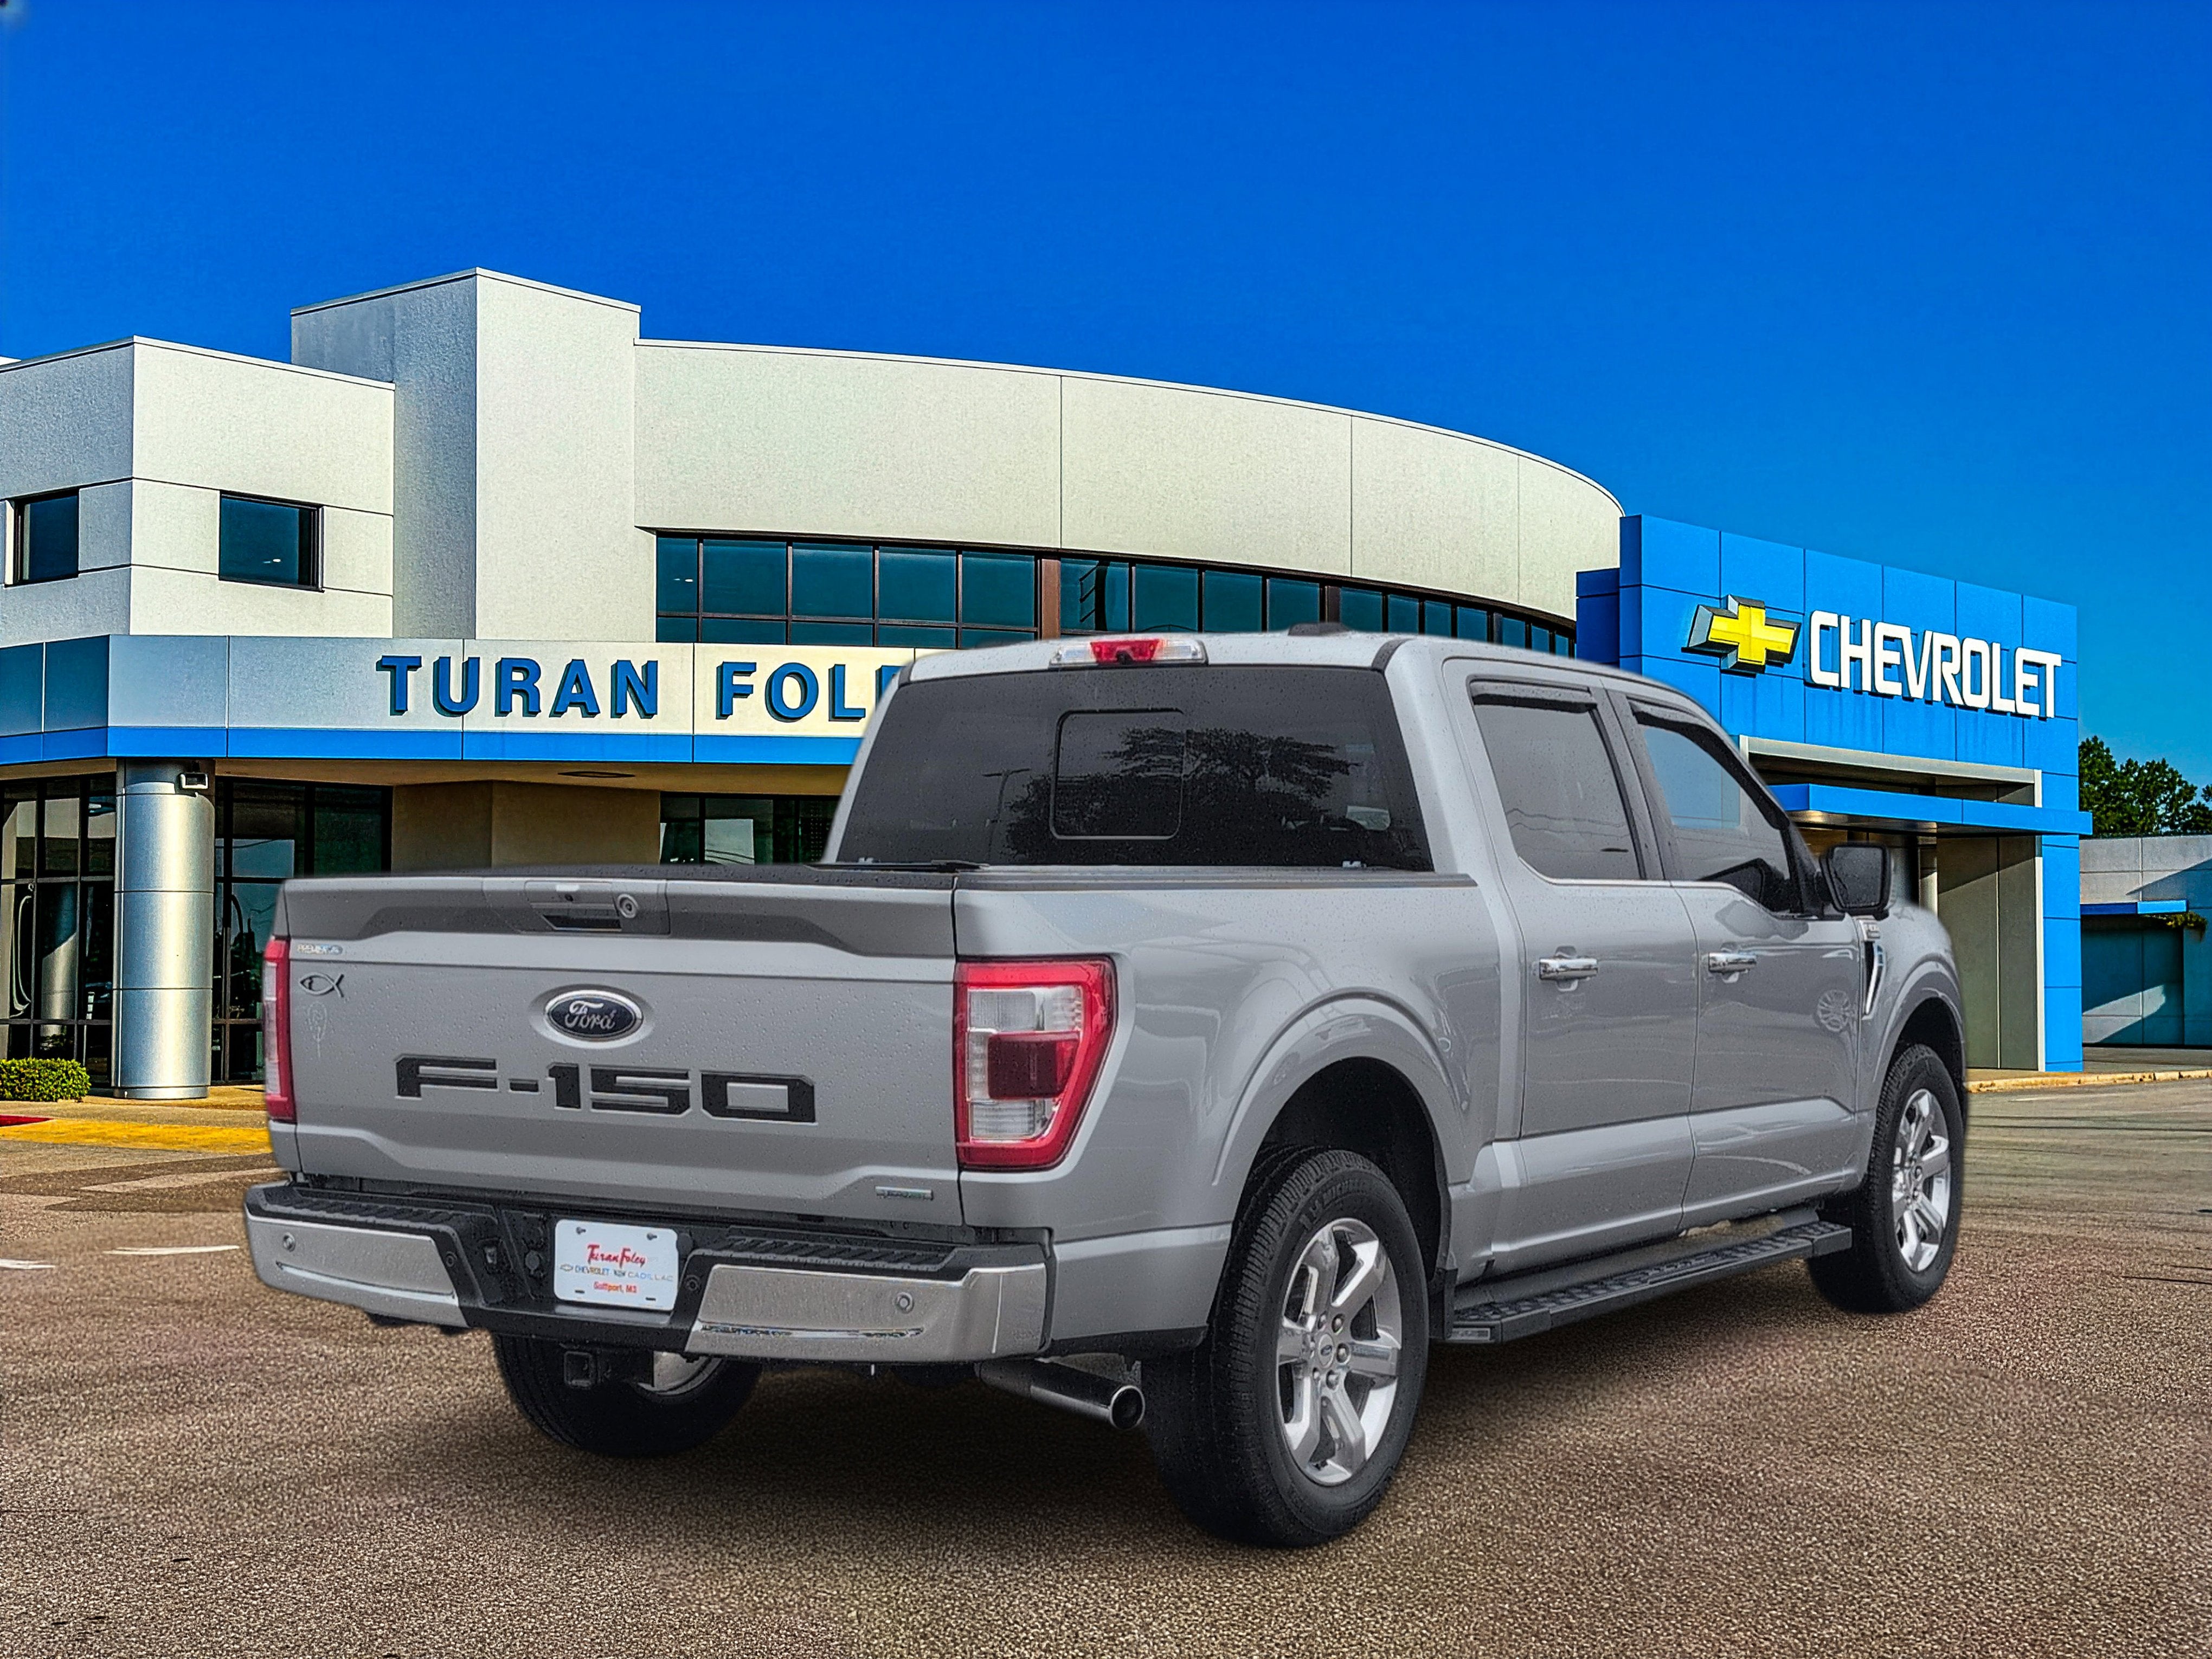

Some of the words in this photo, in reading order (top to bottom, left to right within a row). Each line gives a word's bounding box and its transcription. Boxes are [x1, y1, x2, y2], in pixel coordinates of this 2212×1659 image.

[376, 655, 659, 719] TURAN
[1809, 610, 2062, 718] CHEVROLET
[564, 1000, 617, 1030] Ford
[395, 1054, 816, 1124] F-150
